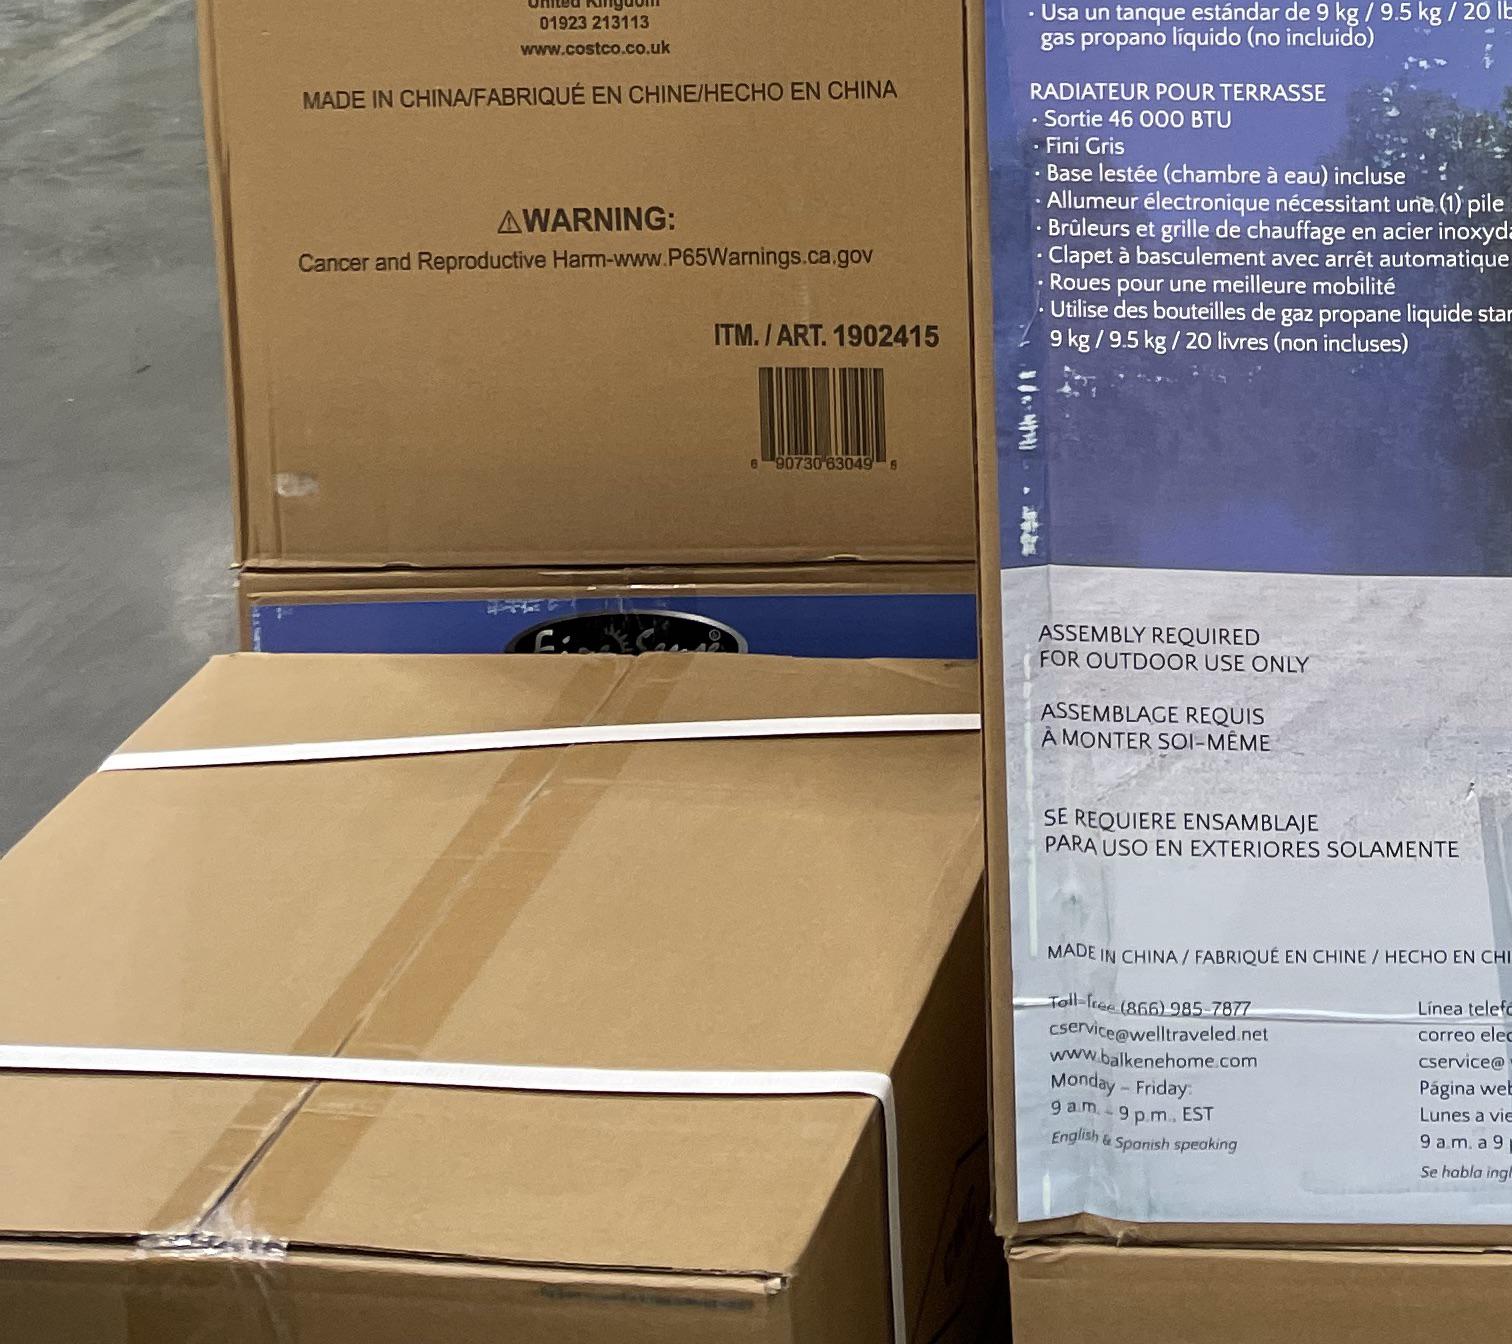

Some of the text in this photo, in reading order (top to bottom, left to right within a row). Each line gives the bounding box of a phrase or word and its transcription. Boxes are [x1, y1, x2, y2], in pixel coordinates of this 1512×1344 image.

[302, 79, 898, 110] MADE IN CHINA/FABRIQUÉ EN CHINE/HECHO EN CHINA
[1029, 81, 1328, 104] RADIATEUR POUR TERRASSE
[522, 205, 676, 234] WARNING:
[298, 252, 370, 274] Cancer
[374, 251, 412, 272] and
[417, 249, 548, 275] Reproductive
[714, 323, 941, 348] ITM. / ART. 1902415
[1038, 623, 1261, 648] ASSEMBLY REQUIRED
[1039, 649, 1310, 675] FOR OUTDOOR USE ONLY
[1051, 1127, 1239, 1155] English & Spanish speaking
